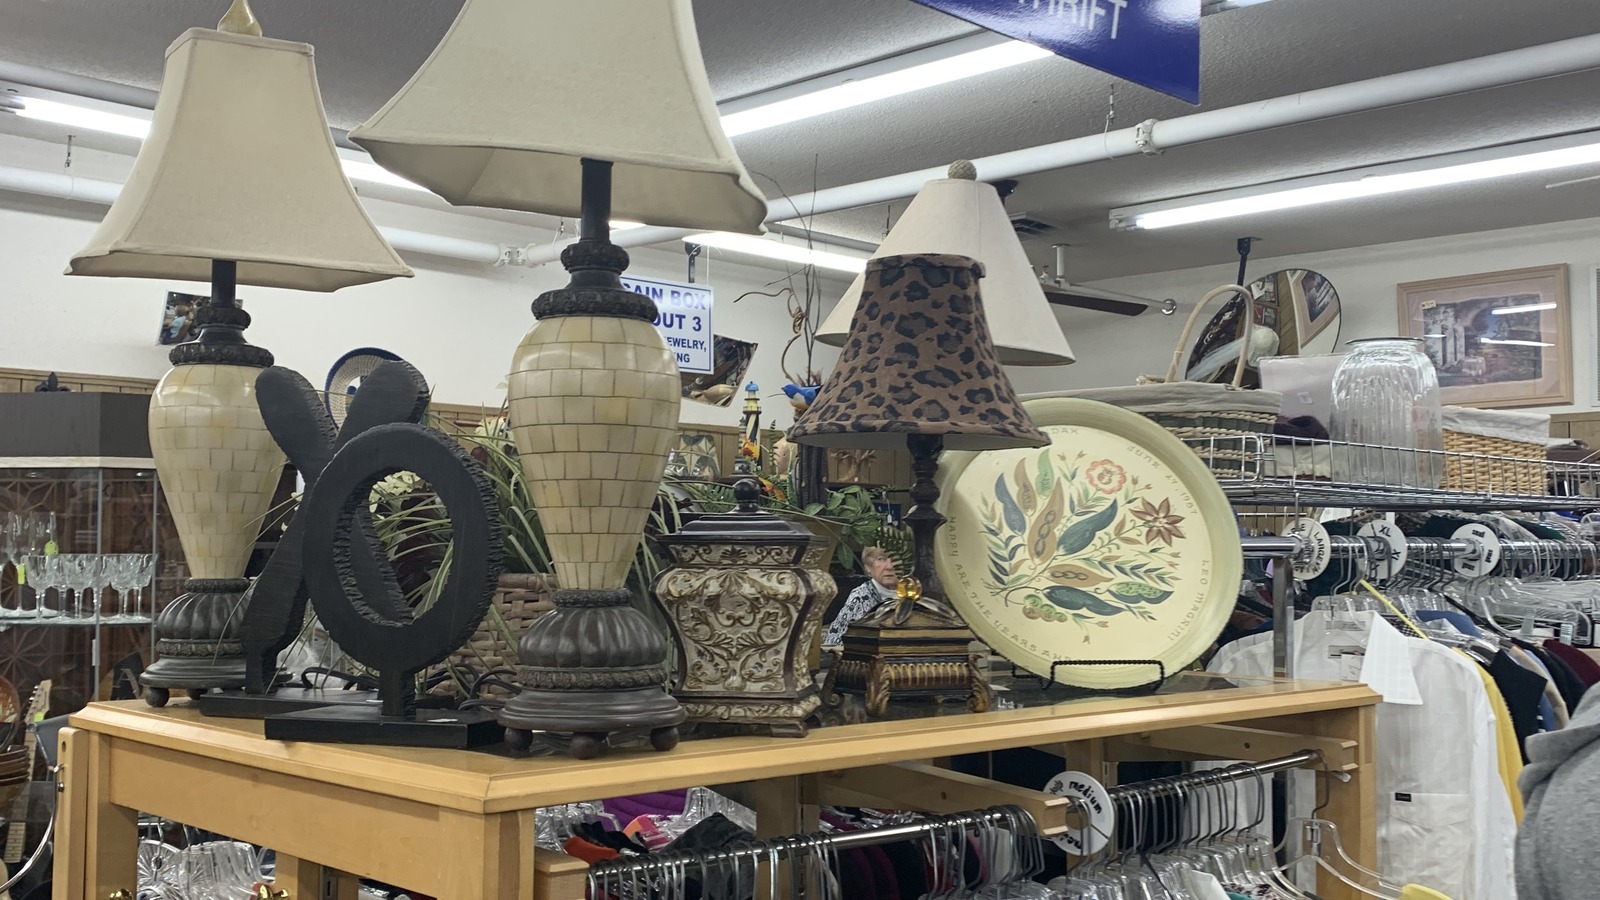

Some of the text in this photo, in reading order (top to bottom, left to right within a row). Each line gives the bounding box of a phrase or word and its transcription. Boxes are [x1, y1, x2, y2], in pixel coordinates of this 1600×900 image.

[670, 290, 706, 310] BOX
[692, 316, 702, 332] 3
[664, 336, 707, 352] EWELRY,
[673, 352, 690, 363] NG
[1379, 525, 1391, 538] XL
[1068, 781, 1103, 814] medium
